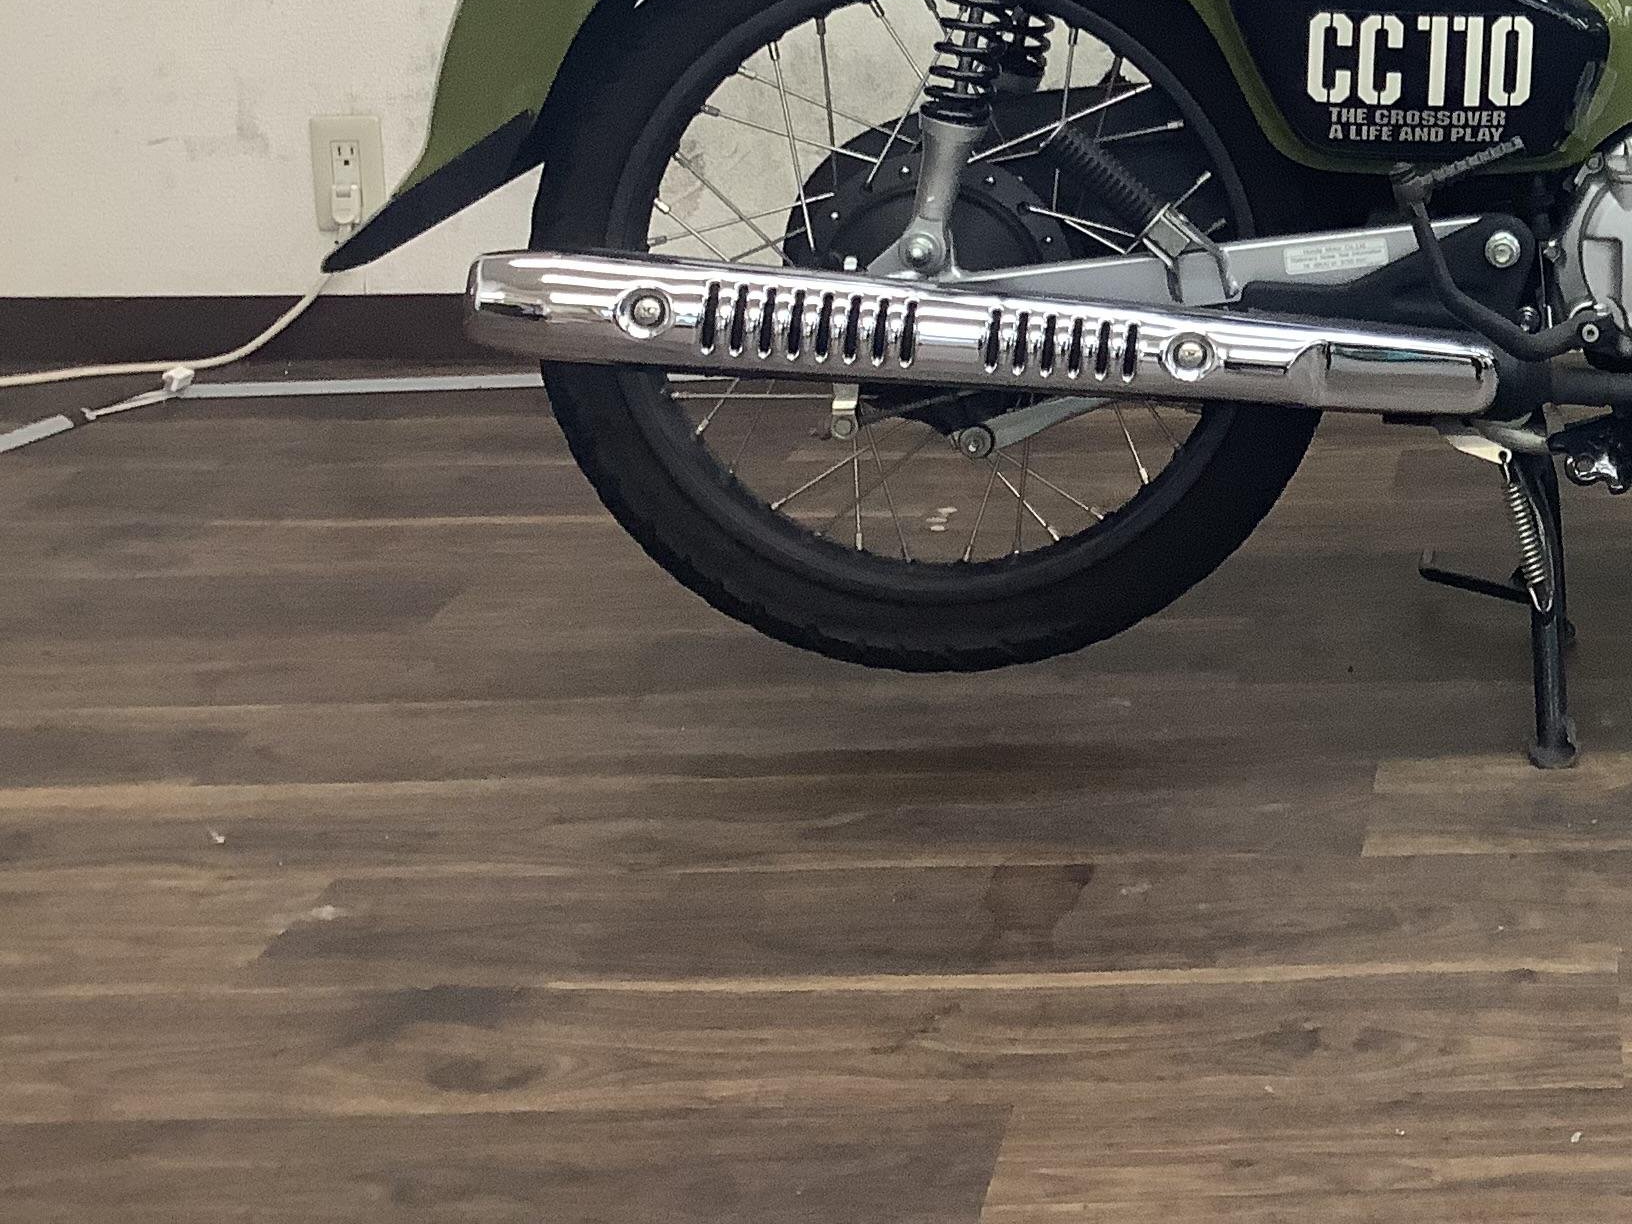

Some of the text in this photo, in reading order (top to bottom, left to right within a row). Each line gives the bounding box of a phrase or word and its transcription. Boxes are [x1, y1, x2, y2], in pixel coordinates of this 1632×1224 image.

[1328, 107, 1506, 126] THE CROSSOVER
[1328, 125, 1505, 143] A LIFE AND PLAY
